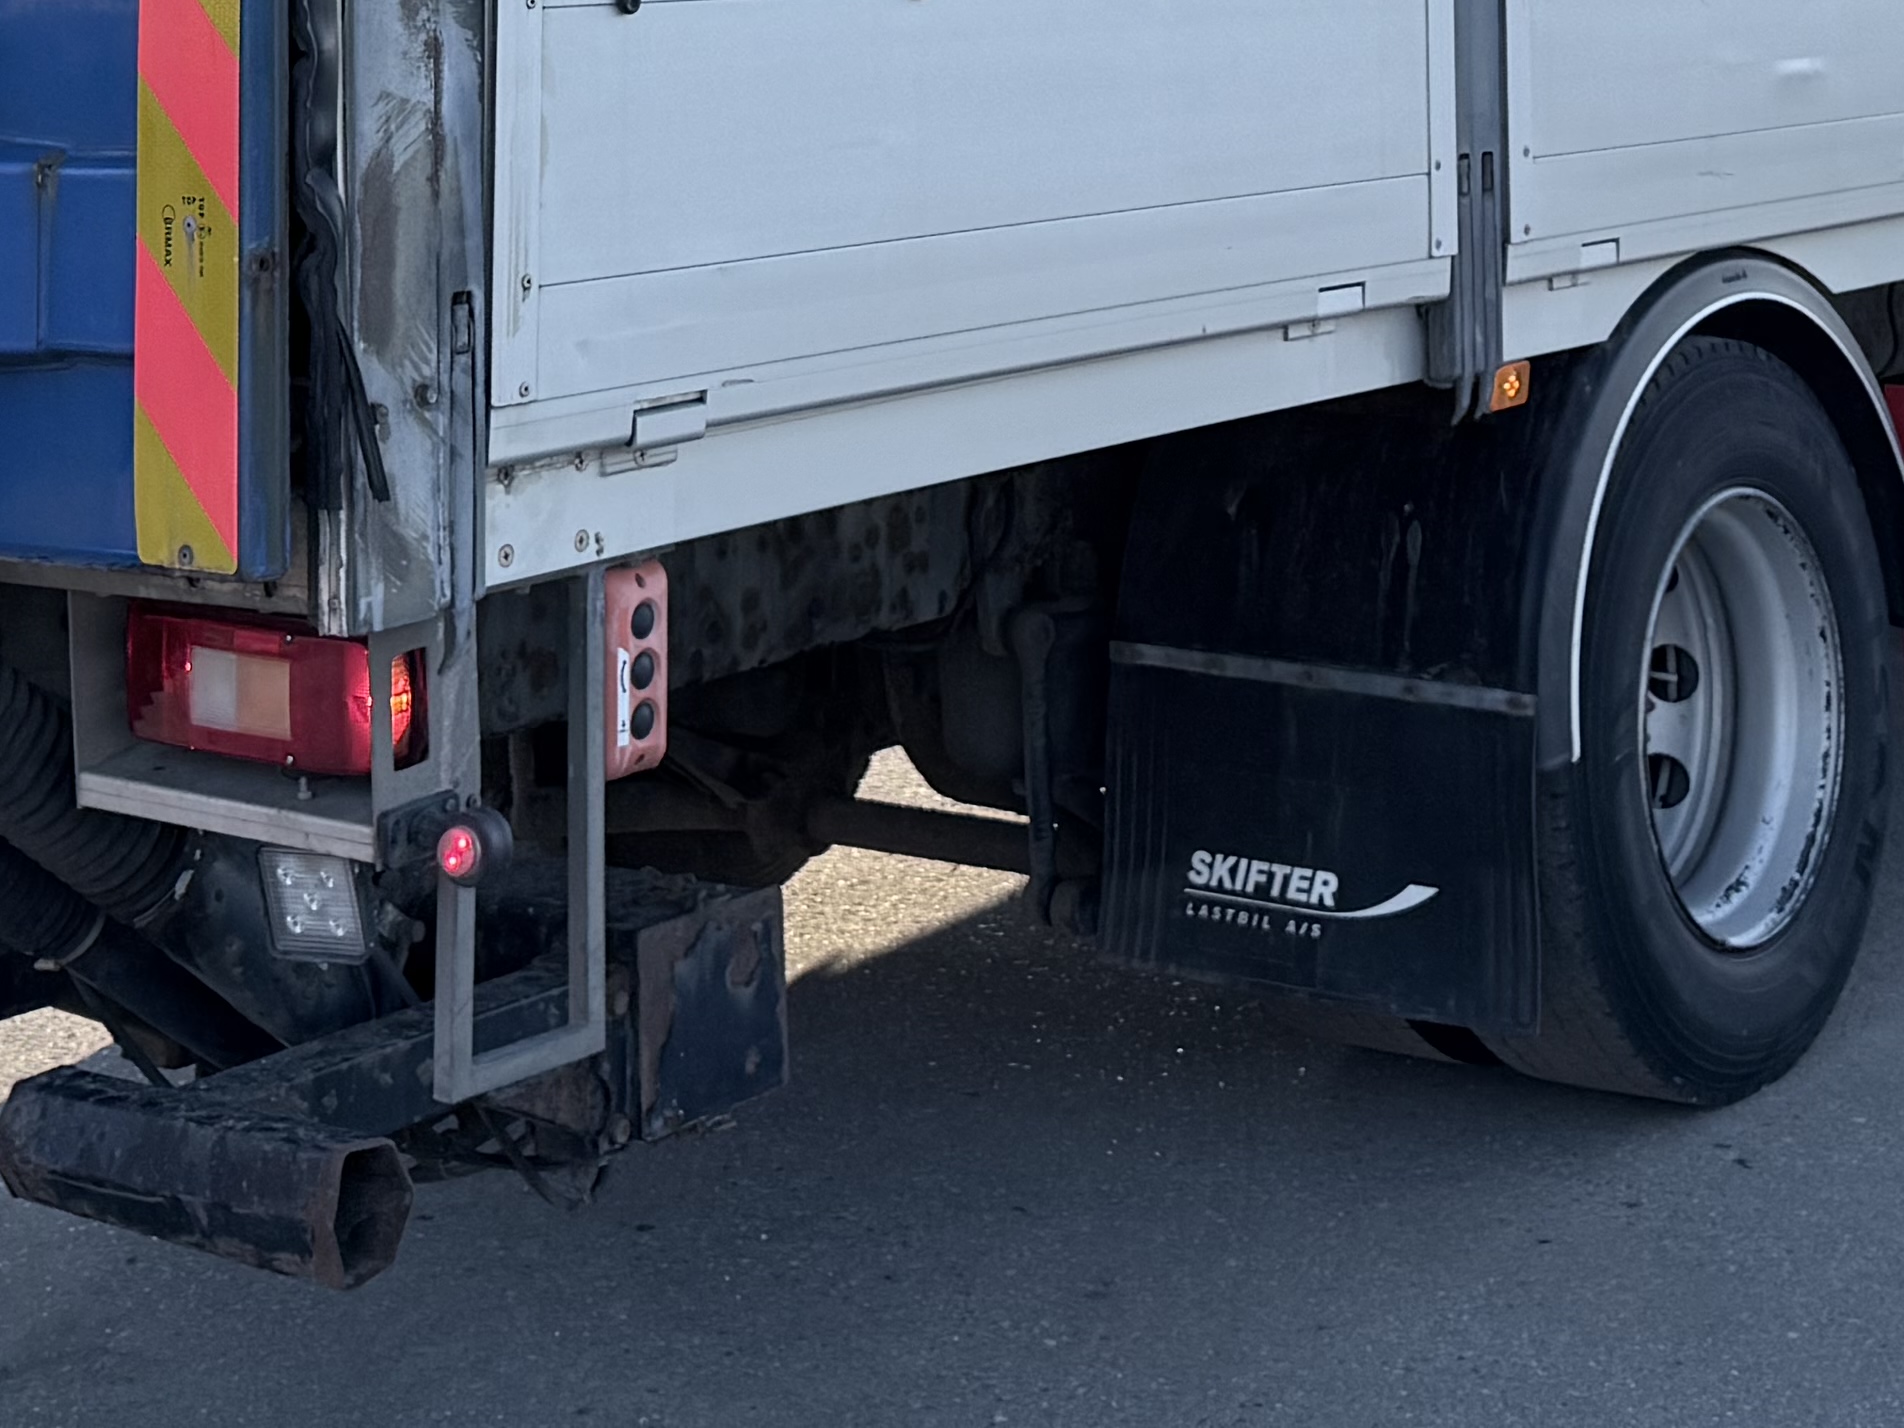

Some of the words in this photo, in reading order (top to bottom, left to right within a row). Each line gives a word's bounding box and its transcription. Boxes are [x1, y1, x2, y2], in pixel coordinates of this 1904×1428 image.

[1187, 849, 1339, 907] SKIFTER
[1186, 902, 1271, 930] LASTBIL
[1285, 919, 1322, 938] A/S
